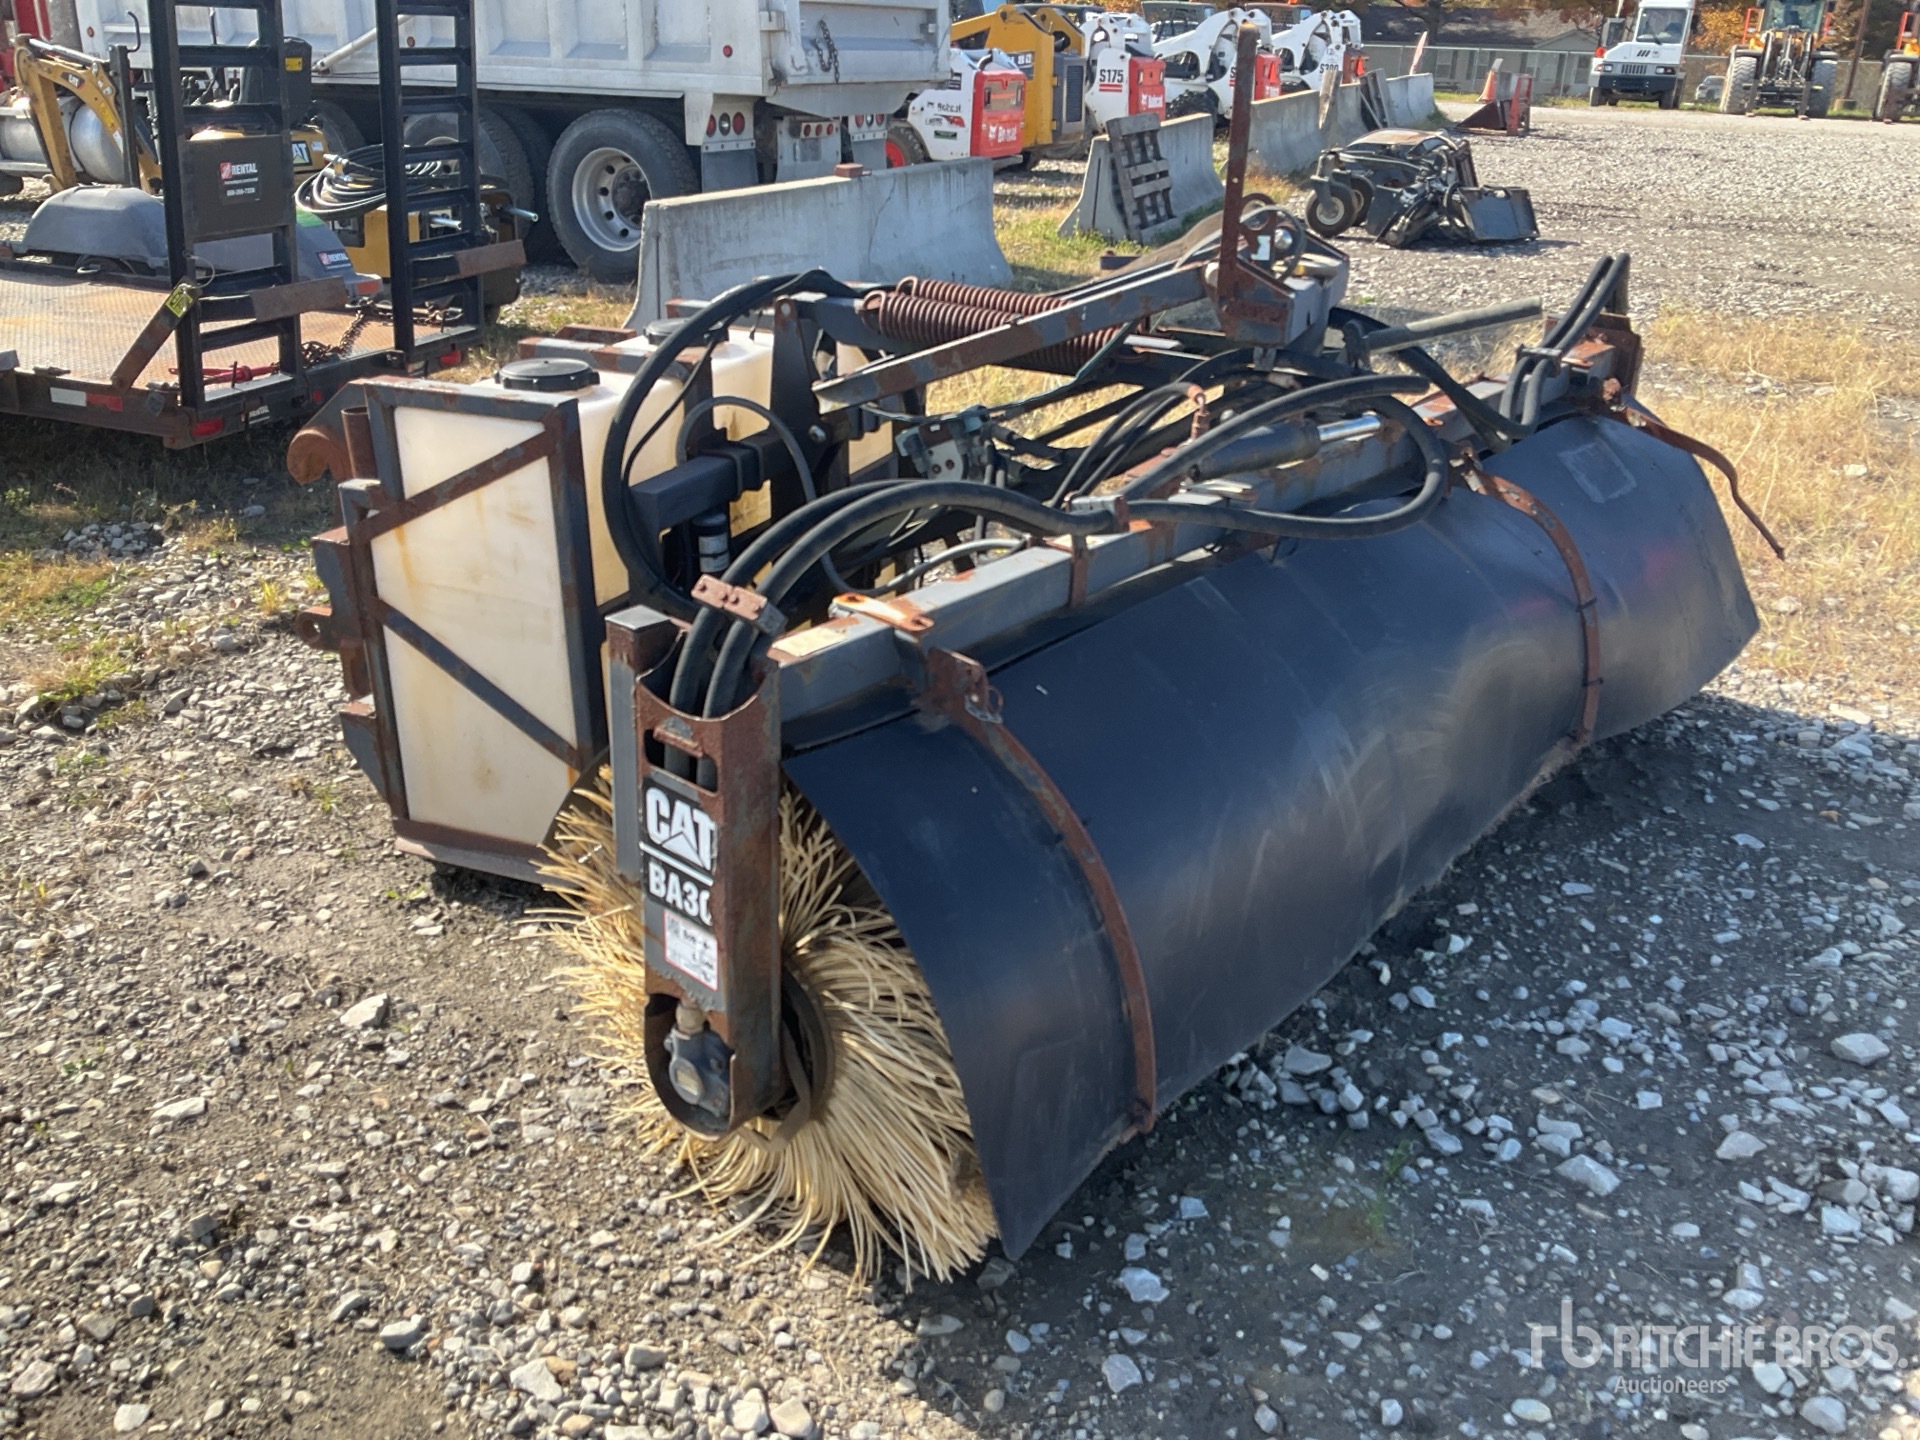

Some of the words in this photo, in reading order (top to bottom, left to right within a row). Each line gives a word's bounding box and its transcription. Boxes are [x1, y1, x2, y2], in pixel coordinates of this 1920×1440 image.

[1099, 69, 1124, 83] S175
[291, 143, 310, 164] AT
[231, 163, 258, 175] RENTAL
[646, 787, 715, 871] CAT
